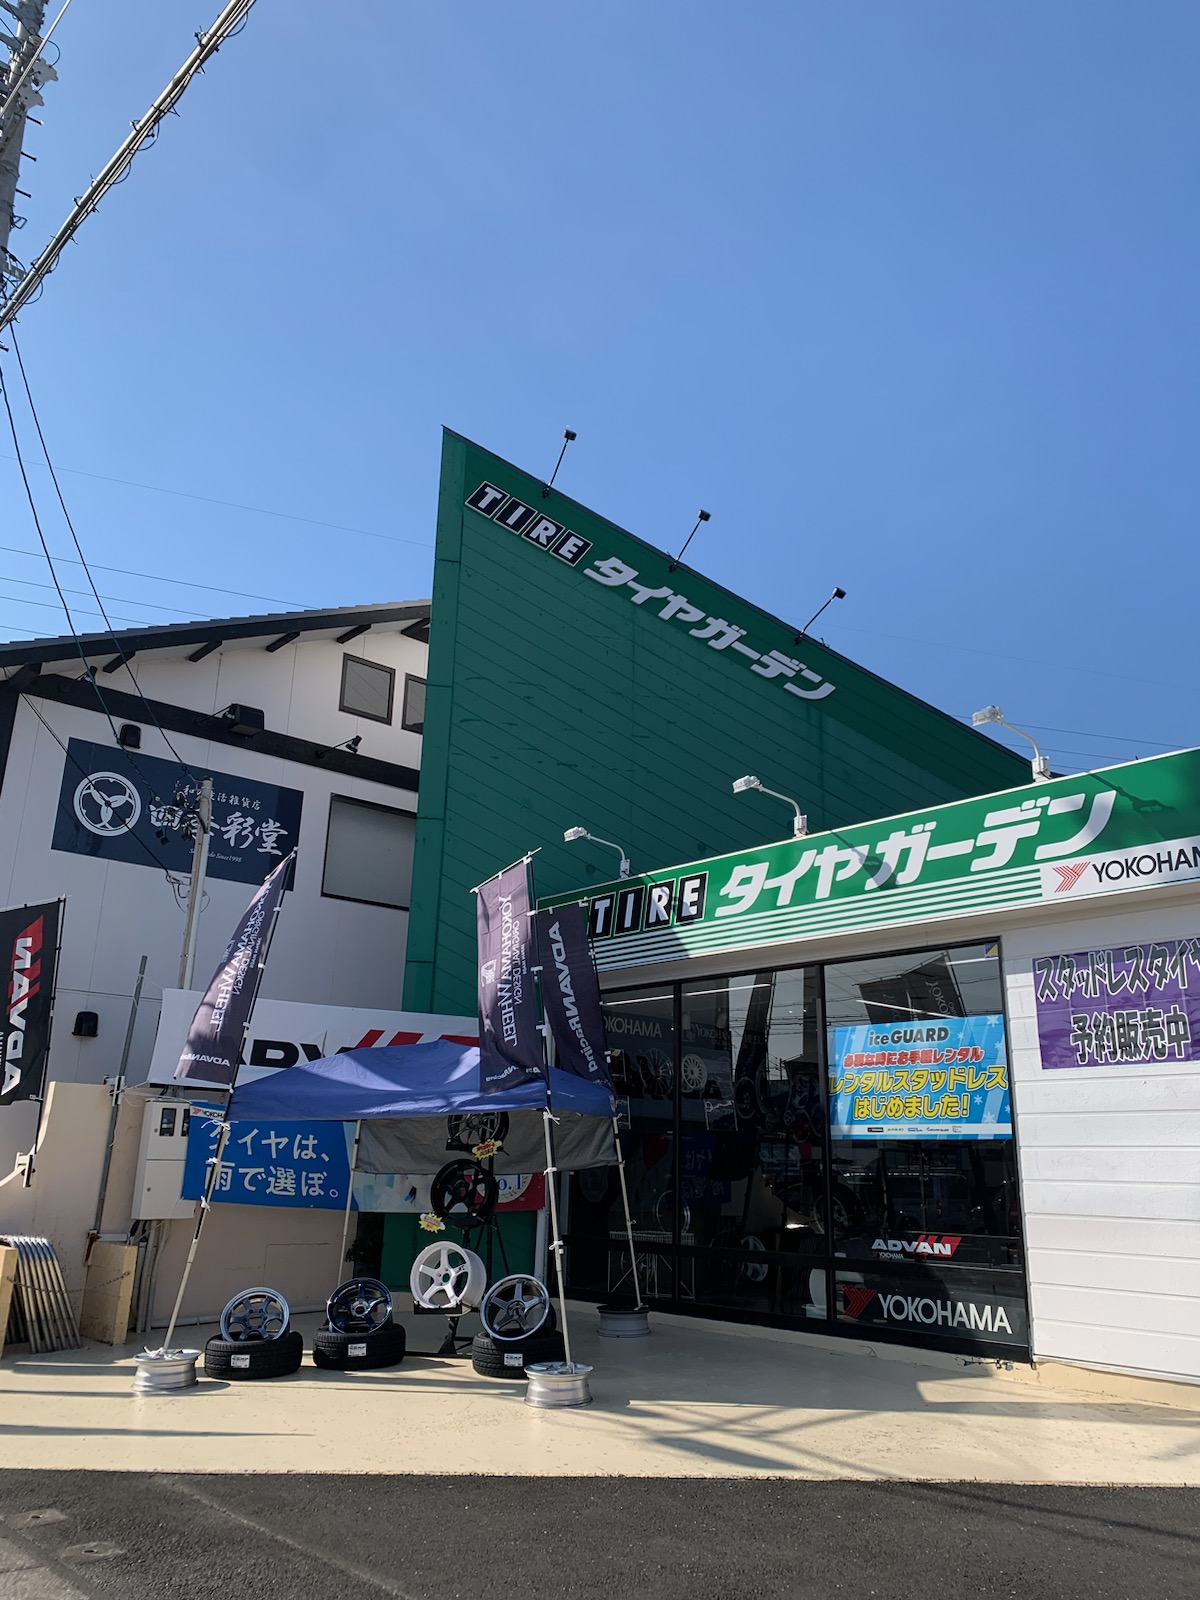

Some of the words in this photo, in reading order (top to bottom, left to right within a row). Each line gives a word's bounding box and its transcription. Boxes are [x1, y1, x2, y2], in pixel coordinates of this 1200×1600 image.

[476, 484, 587, 560] TIRE
[583, 556, 837, 700] タイヤガーデン
[715, 790, 1117, 918] タイヤガーデン
[594, 877, 701, 934] TIRE
[869, 1027, 950, 1046] iceGUARD
[1070, 1005, 1192, 1065] 予約販売中
[844, 1047, 985, 1068] 必要な時にお手軽レンタル
[829, 1066, 1008, 1095] レンタルスタッドレス
[205, 1160, 339, 1198] 雨で選ぼ。
[871, 1238, 951, 1255] ADVAN
[877, 1293, 1013, 1334] YOKOHAMA
